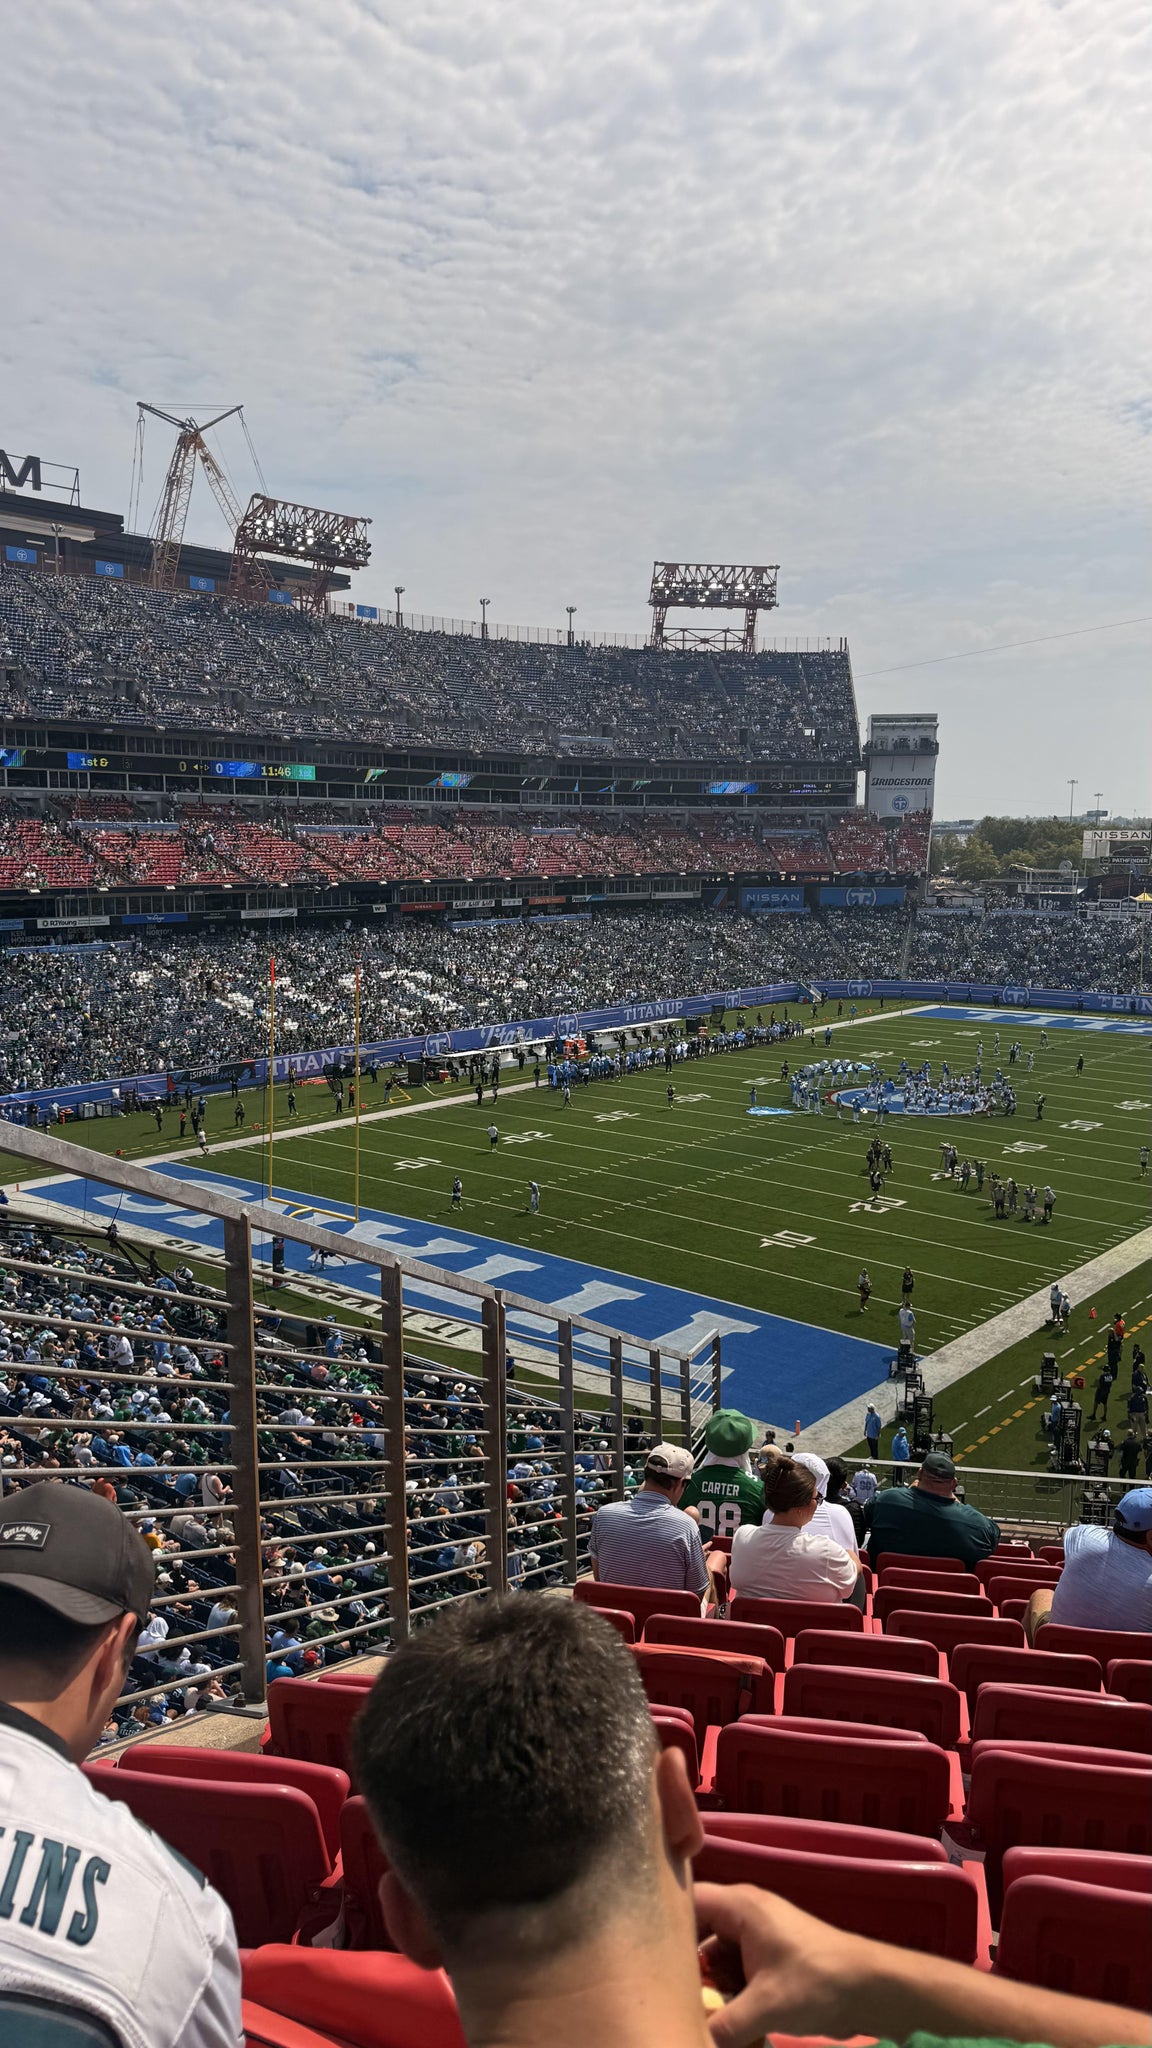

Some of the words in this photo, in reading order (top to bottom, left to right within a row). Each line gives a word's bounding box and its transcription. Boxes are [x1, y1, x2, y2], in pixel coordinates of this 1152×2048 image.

[80, 757, 98, 766] 1st
[215, 763, 224, 774] 0
[261, 766, 291, 777] 11:46
[871, 777, 934, 786] BRIDGESTONE
[1093, 831, 1151, 839] NISSAN
[746, 893, 800, 902] NISSAN
[623, 1007, 665, 1022] TITAN
[666, 1002, 684, 1016] UP
[480, 1024, 534, 1048] Titas
[267, 1051, 335, 1079] TITAN
[1058, 1118, 1105, 1132] 50
[502, 1130, 554, 1145] 20
[1001, 1140, 1049, 1155] 40
[847, 1196, 908, 1215] 20
[759, 1229, 818, 1249] 10
[701, 1480, 740, 1497] CARTER
[697, 1501, 742, 1537] 98
[0, 1827, 111, 1947] INS
